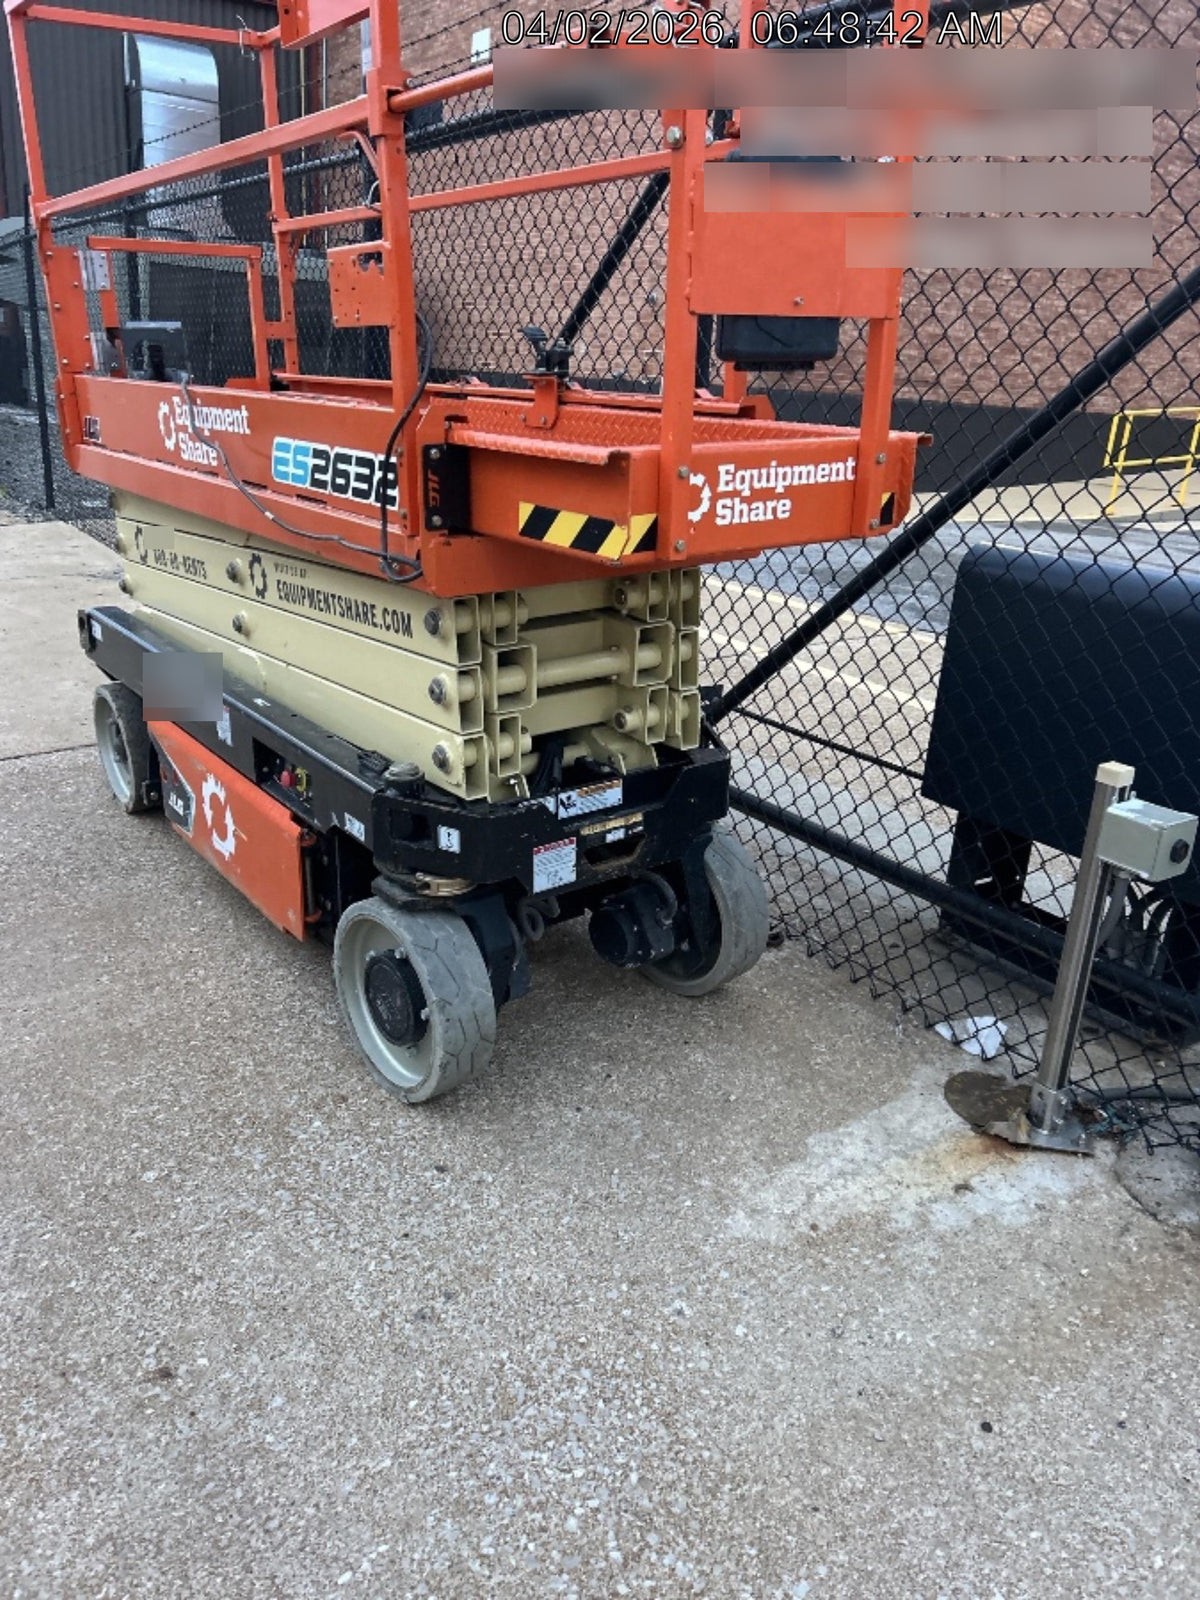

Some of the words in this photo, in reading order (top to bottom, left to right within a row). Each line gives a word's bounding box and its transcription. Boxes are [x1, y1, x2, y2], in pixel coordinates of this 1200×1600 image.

[177, 431, 218, 467] Share
[273, 437, 398, 510] ES2632
[427, 468, 440, 508] JLG
[716, 456, 857, 497] Equipment
[714, 497, 792, 527] Share
[276, 579, 413, 639] EQUIPMENTSHARE.COM
